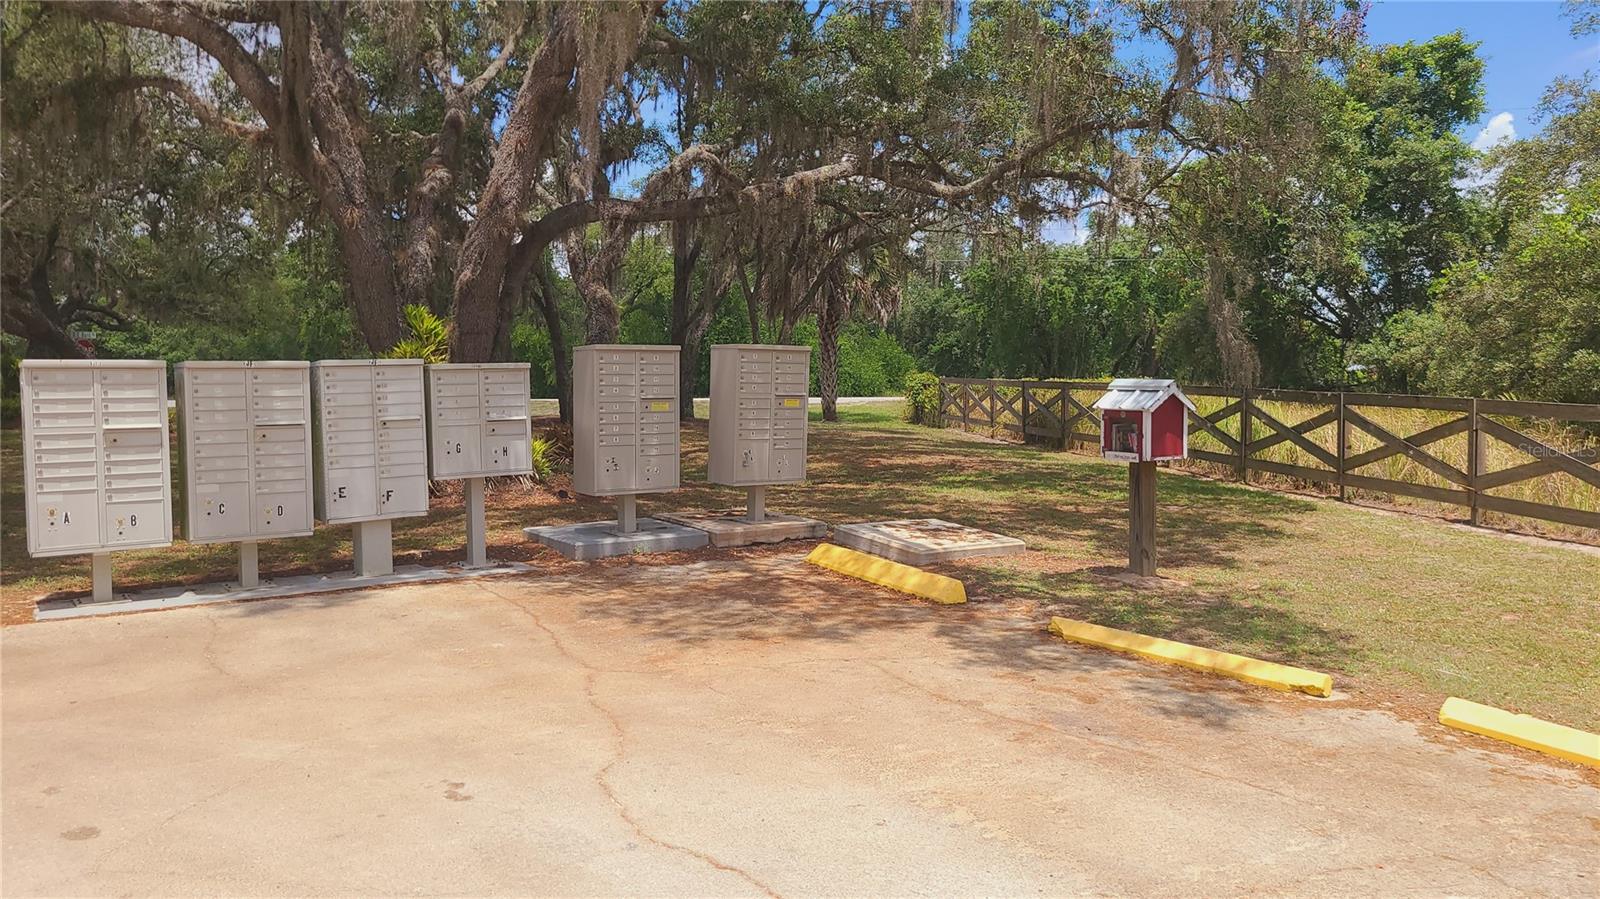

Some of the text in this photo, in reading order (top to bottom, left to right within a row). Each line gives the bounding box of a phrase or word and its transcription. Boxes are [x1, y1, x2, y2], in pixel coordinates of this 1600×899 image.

[455, 442, 462, 454] G
[502, 446, 509, 457] H
[338, 487, 347, 499] E
[386, 490, 394, 502] F
[218, 503, 225, 515] C
[277, 505, 284, 517] D
[63, 512, 71, 525] A
[130, 515, 138, 527] B
